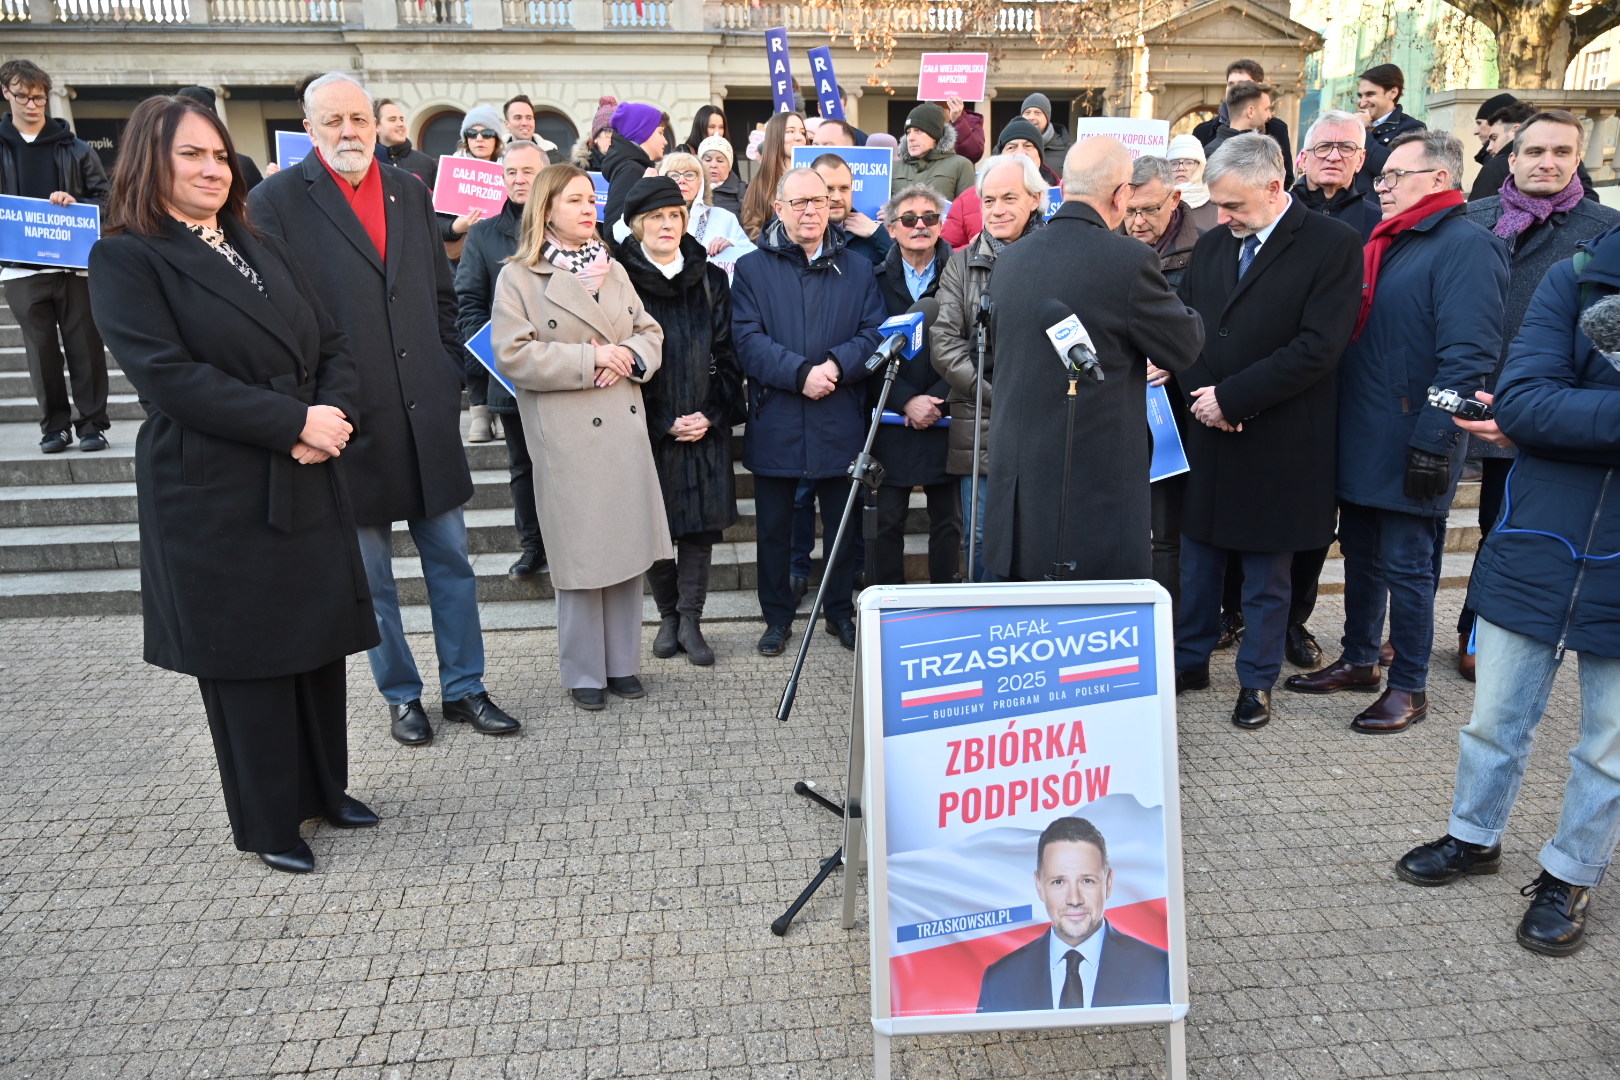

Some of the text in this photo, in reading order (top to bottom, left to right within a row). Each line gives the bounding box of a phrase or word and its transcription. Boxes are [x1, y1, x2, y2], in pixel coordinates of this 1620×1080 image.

[771, 37, 790, 113] RAFA
[937, 74, 968, 84] NAPRZÓD!
[939, 64, 984, 73] WIELKOPOLSKA
[814, 56, 835, 115] RAF
[87, 136, 114, 150] mpik
[452, 167, 506, 187] CAŁA POLSK
[458, 182, 503, 201] NAPRZÓD!
[0, 208, 96, 230] CAŁA WIELKOPOLSKA
[24, 225, 71, 241] NAPRZÓD!
[989, 618, 1052, 642] RAFAŁ
[900, 625, 1139, 681] TRZASKOWSKI
[997, 671, 1047, 693] 2025
[933, 684, 1110, 720] BUDUJEMY PROGRAM DLA POLSKI
[945, 720, 1087, 777] ZBIÓRKA
[938, 760, 1111, 828] PODPISÓW
[916, 909, 1013, 938] TRZASKOWSKI.PL
